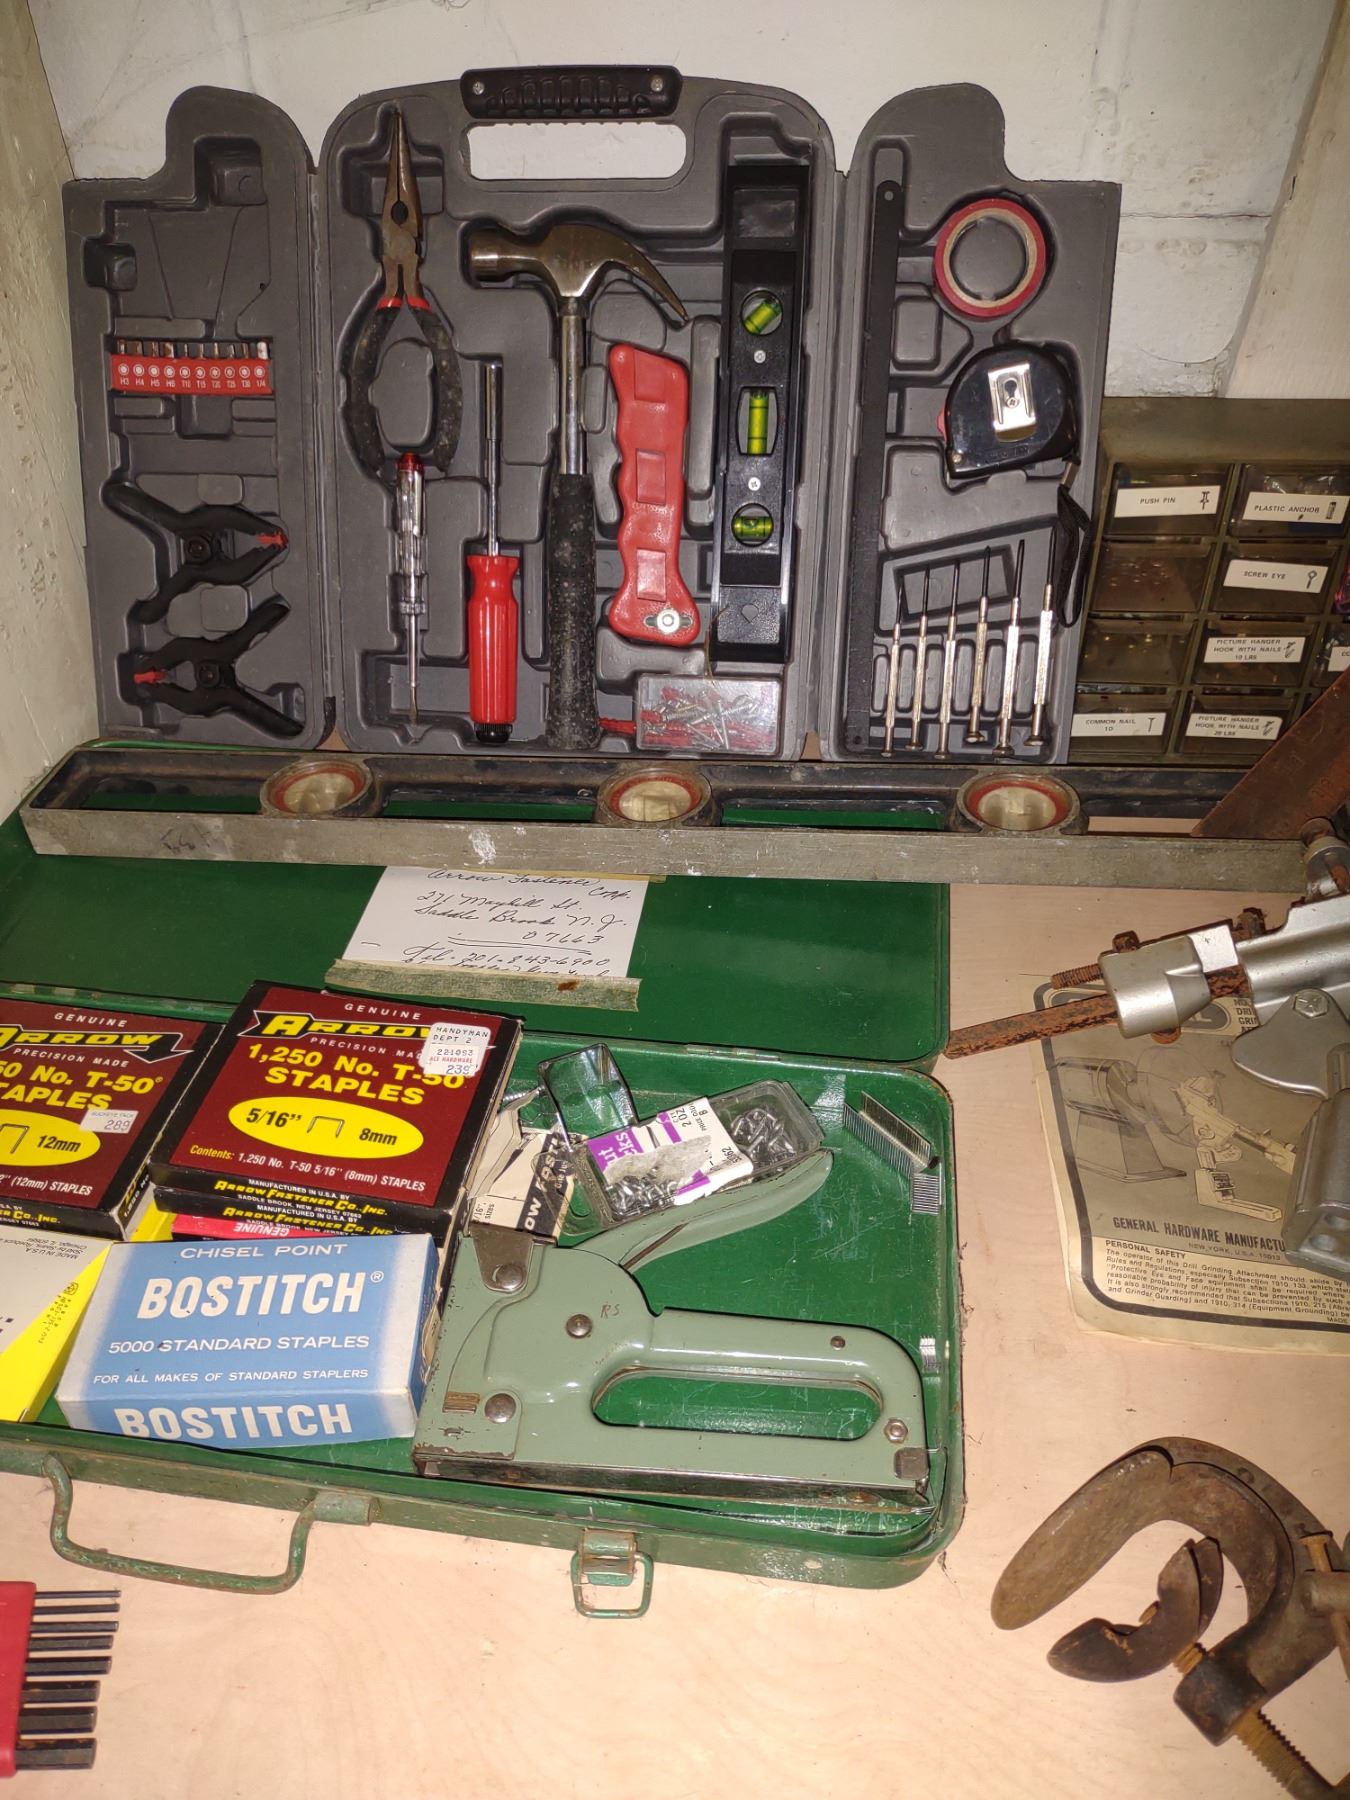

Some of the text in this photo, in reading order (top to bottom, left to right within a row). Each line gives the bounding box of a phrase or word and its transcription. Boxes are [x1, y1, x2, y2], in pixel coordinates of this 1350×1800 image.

[1254, 505, 1286, 513] PLASTIC
[416, 890, 455, 904] 271
[54, 1012, 128, 1028] GENUINE
[344, 1003, 422, 1020] GENUINE
[433, 1034, 459, 1042] DEPT
[436, 1027, 489, 1037] HANDYMAN
[310, 1037, 387, 1055] PRECISION
[14, 1048, 130, 1068] PRECISION MADE
[248, 1043, 323, 1068] 1,250
[333, 1056, 380, 1078] No.
[29, 1065, 73, 1085] No.
[264, 1066, 425, 1106] STAPLES
[103, 1119, 131, 1131] 289
[36, 1134, 81, 1153] 12mm
[358, 1127, 398, 1147] 8mm
[189, 1144, 235, 1161] Contents:
[267, 1157, 285, 1170] No.
[289, 1160, 313, 1174] T-50
[344, 1168, 379, 1185] (8mm)
[380, 1174, 426, 1192] STAPLES
[10, 1175, 48, 1191] (12mm)
[49, 1180, 94, 1197] STAPLES
[213, 1180, 266, 1196] ARROW
[266, 1186, 335, 1207] FASTENER
[248, 1178, 351, 1201] MANUFACTURED IN U.S.A. BY
[237, 1193, 265, 1204] SADDLE
[295, 1202, 313, 1210] NEW
[314, 1206, 340, 1216] JERSEY
[256, 1204, 315, 1218] MANUFACTURED
[316, 1211, 326, 1219] IN
[326, 1213, 347, 1223] U.S.A.
[222, 1207, 344, 1230] ARROW FASTENER
[233, 1222, 290, 1237] GENUINE
[1113, 1216, 1160, 1233] GENERAL
[1164, 1222, 1221, 1243] HARDWARE
[180, 1243, 348, 1259] CHISEL POINT
[1105, 1239, 1187, 1259] PERSONAL SAFETY
[1188, 1242, 1206, 1250] NEW
[55, 1252, 79, 1260] MADE
[1123, 1251, 1305, 1283] operator Grinding Attachment should
[1189, 1269, 1269, 1286] especially Subsection
[1106, 1272, 1310, 1303] reasonable probability injury prevented
[1141, 1282, 1289, 1307] strongly recommended Subsections
[1208, 1278, 1318, 1297] equipment required
[1125, 1287, 1339, 1318] Grinder Guarding) (Equipment Grounding)
[108, 1335, 370, 1354] 5000 STANDARD STAPLES
[93, 1368, 369, 1385] FOR ALL MAKES OF STANDARD STAPLERS
[113, 1403, 353, 1440] BOSTITCH
